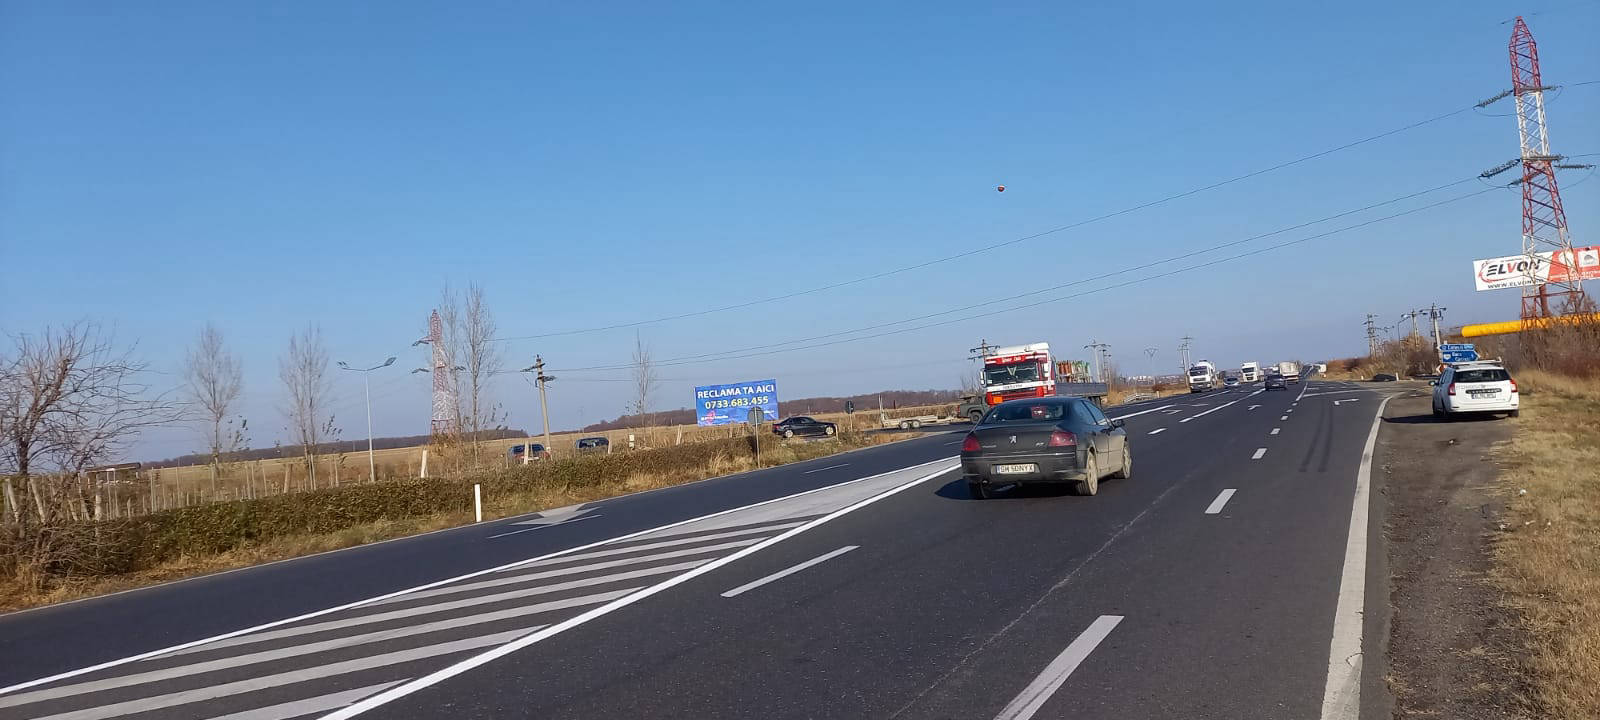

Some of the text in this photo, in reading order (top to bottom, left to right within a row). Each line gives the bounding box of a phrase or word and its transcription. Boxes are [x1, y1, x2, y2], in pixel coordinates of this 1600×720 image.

[697, 384, 774, 399] RECLAMA TA AICI
[705, 396, 769, 409] 0733.683.455
